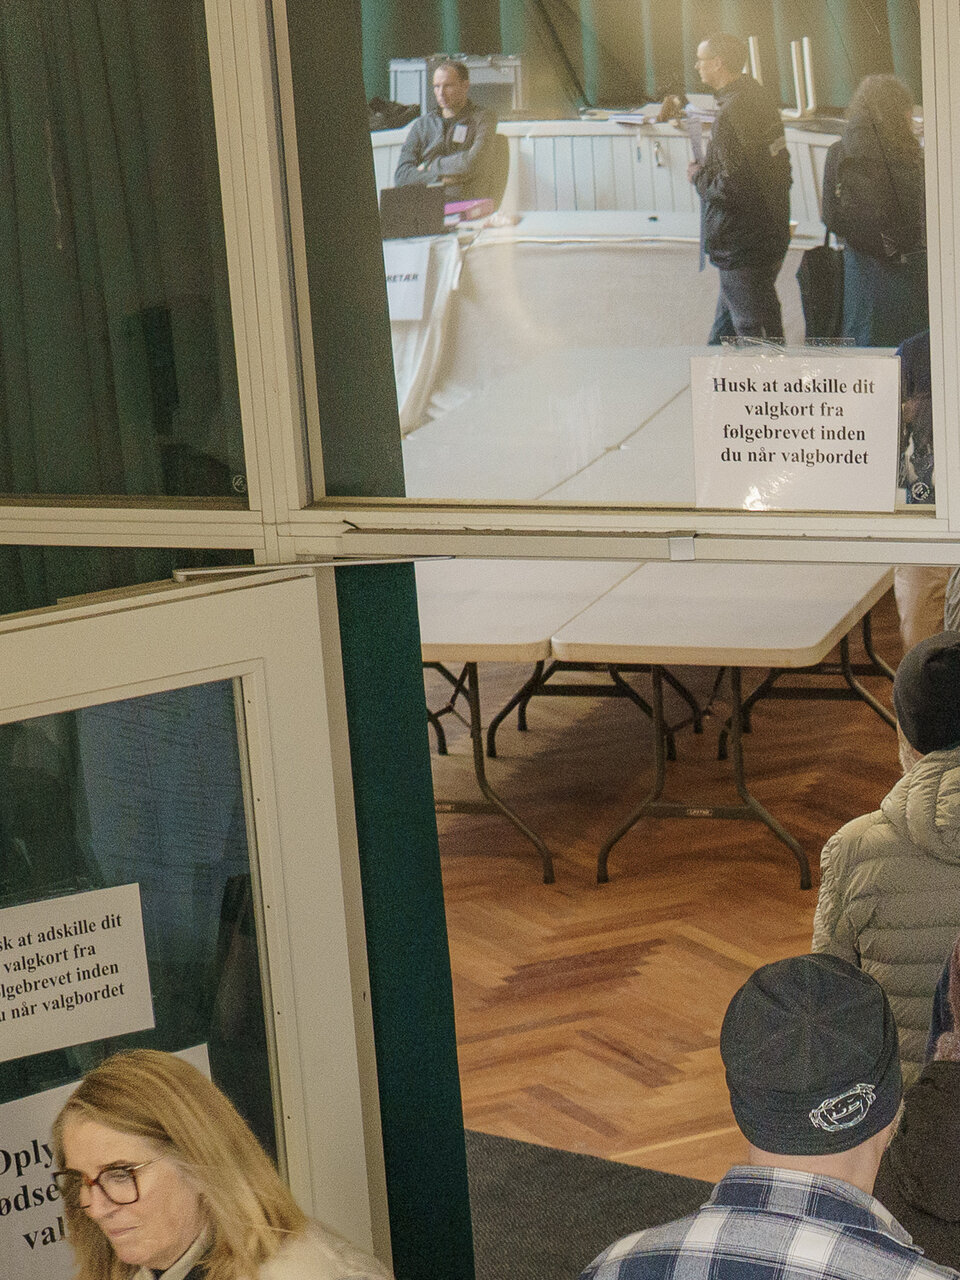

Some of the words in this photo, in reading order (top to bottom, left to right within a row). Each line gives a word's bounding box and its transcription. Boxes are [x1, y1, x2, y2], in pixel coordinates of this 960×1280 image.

[386, 273, 418, 282] RETÆR
[713, 377, 757, 393] Husk
[763, 380, 778, 393] at
[784, 379, 847, 393] adskille
[852, 379, 875, 394] dit
[744, 402, 814, 419] valgkort
[820, 402, 844, 417] fra
[723, 424, 815, 443] følgebrevet
[821, 426, 866, 441] inden
[720, 447, 742, 462] du
[748, 447, 776, 462] når
[781, 449, 869, 467] valgbordet
[18, 932, 32, 947] at
[37, 920, 97, 943] adskille
[101, 914, 122, 930] dit
[4, 948, 68, 973] valgkort
[73, 944, 96, 959] fra
[0, 971, 72, 1000] lgebrevet
[76, 963, 119, 981] inden
[11, 1001, 38, 1019] når
[42, 982, 125, 1011] valgbordet
